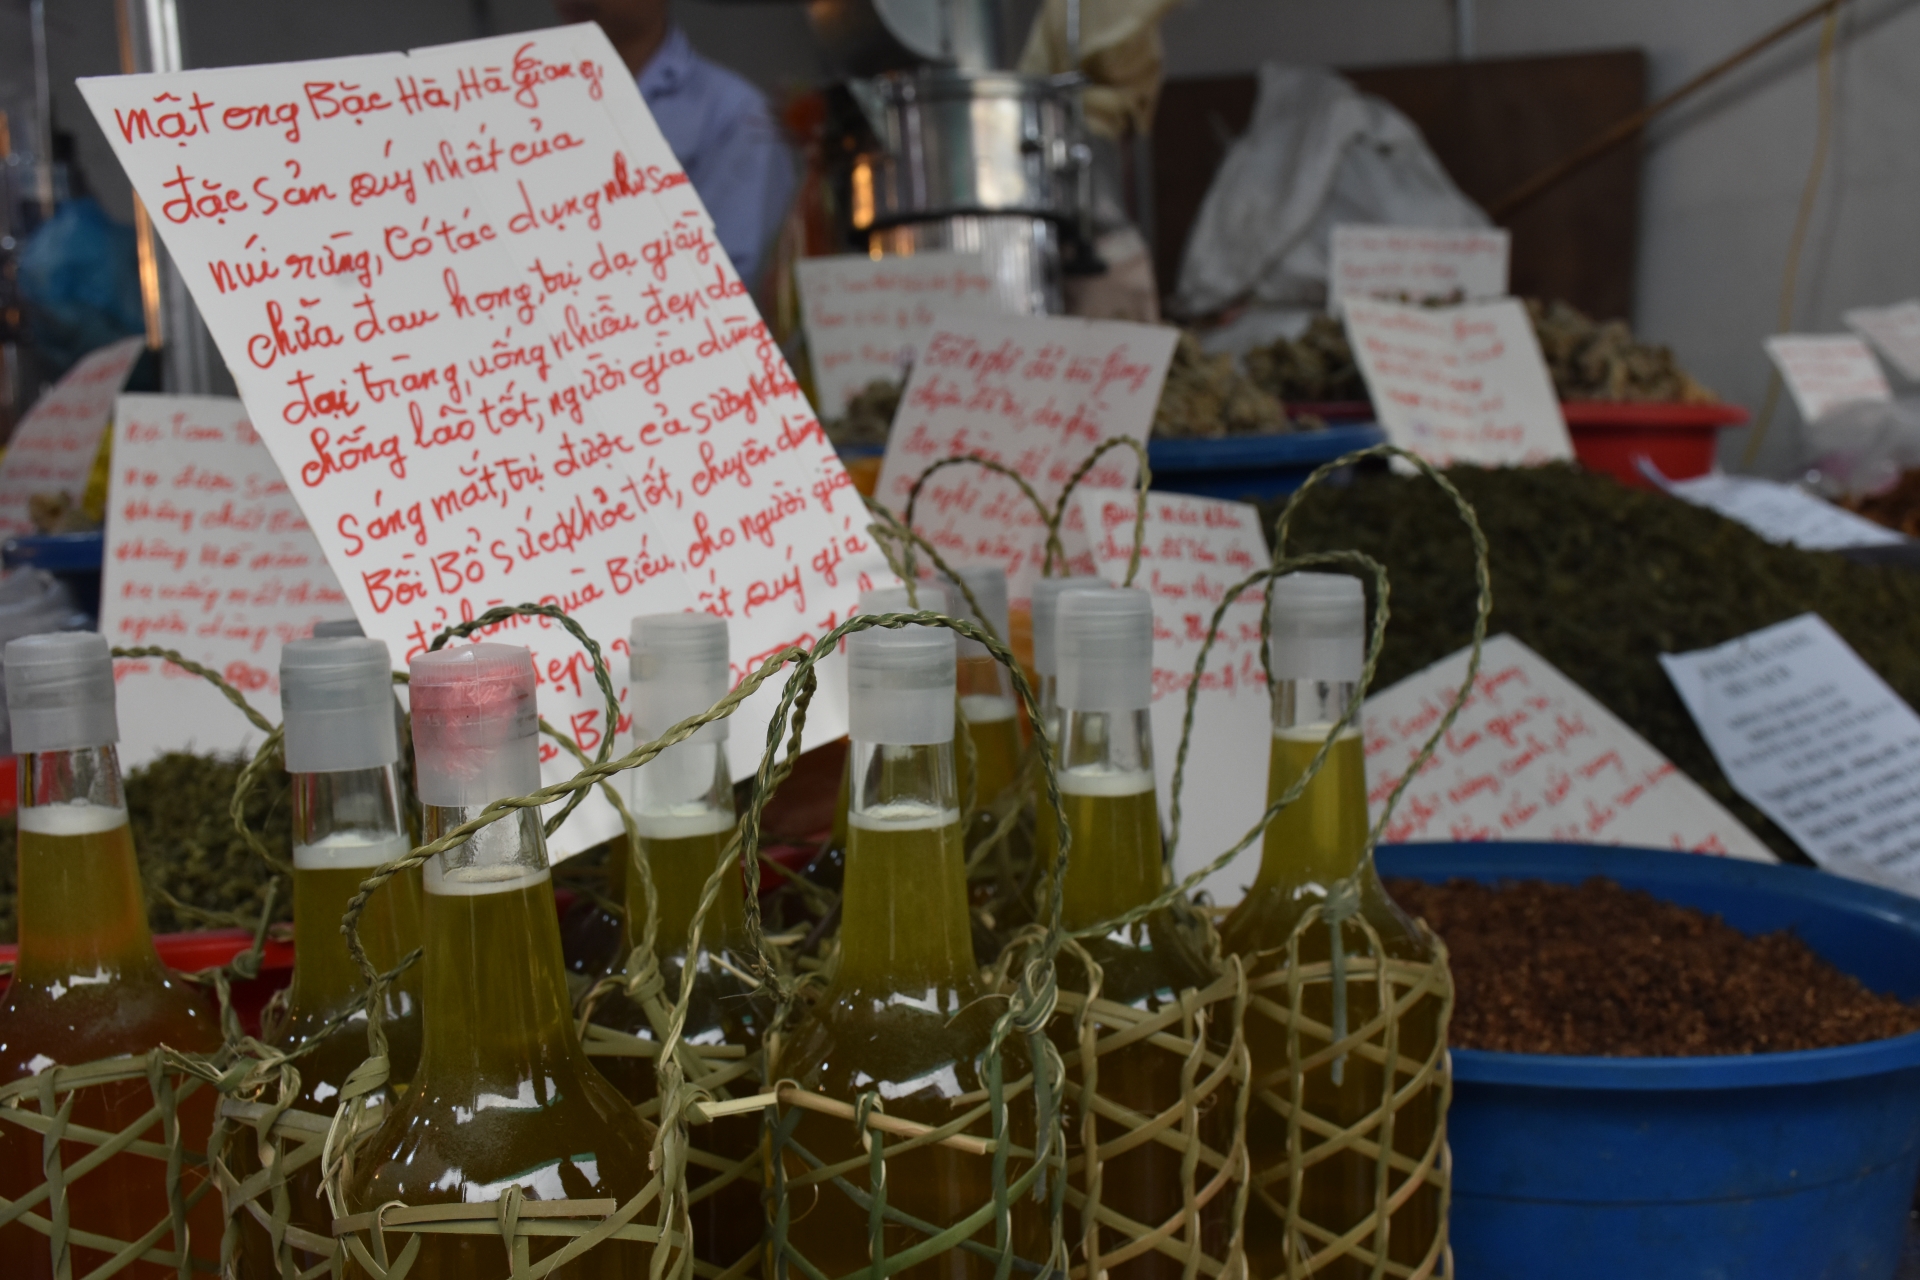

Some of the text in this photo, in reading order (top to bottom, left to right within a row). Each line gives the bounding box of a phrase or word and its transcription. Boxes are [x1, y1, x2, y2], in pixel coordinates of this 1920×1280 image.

[222, 102, 301, 143] ong
[457, 66, 510, 101] Hà
[423, 122, 503, 184] nhất
[510, 117, 585, 165] của
[208, 234, 280, 294] núi
[435, 207, 497, 254] tác
[508, 179, 601, 233] dụng
[604, 150, 645, 204] như
[353, 293, 439, 342] đau
[528, 258, 582, 296] trị
[588, 241, 638, 280] dạ
[283, 370, 360, 425] đại
[468, 326, 551, 383] uống
[550, 293, 640, 360] nhiều
[640, 283, 709, 326] đẹp
[706, 263, 748, 300] da
[549, 352, 626, 424] người
[629, 331, 694, 395] già
[495, 453, 545, 493] trị
[554, 432, 634, 477] được
[682, 563, 735, 617] ất
[812, 514, 868, 588] giá
[688, 510, 736, 568] cho
[738, 480, 807, 548] người
